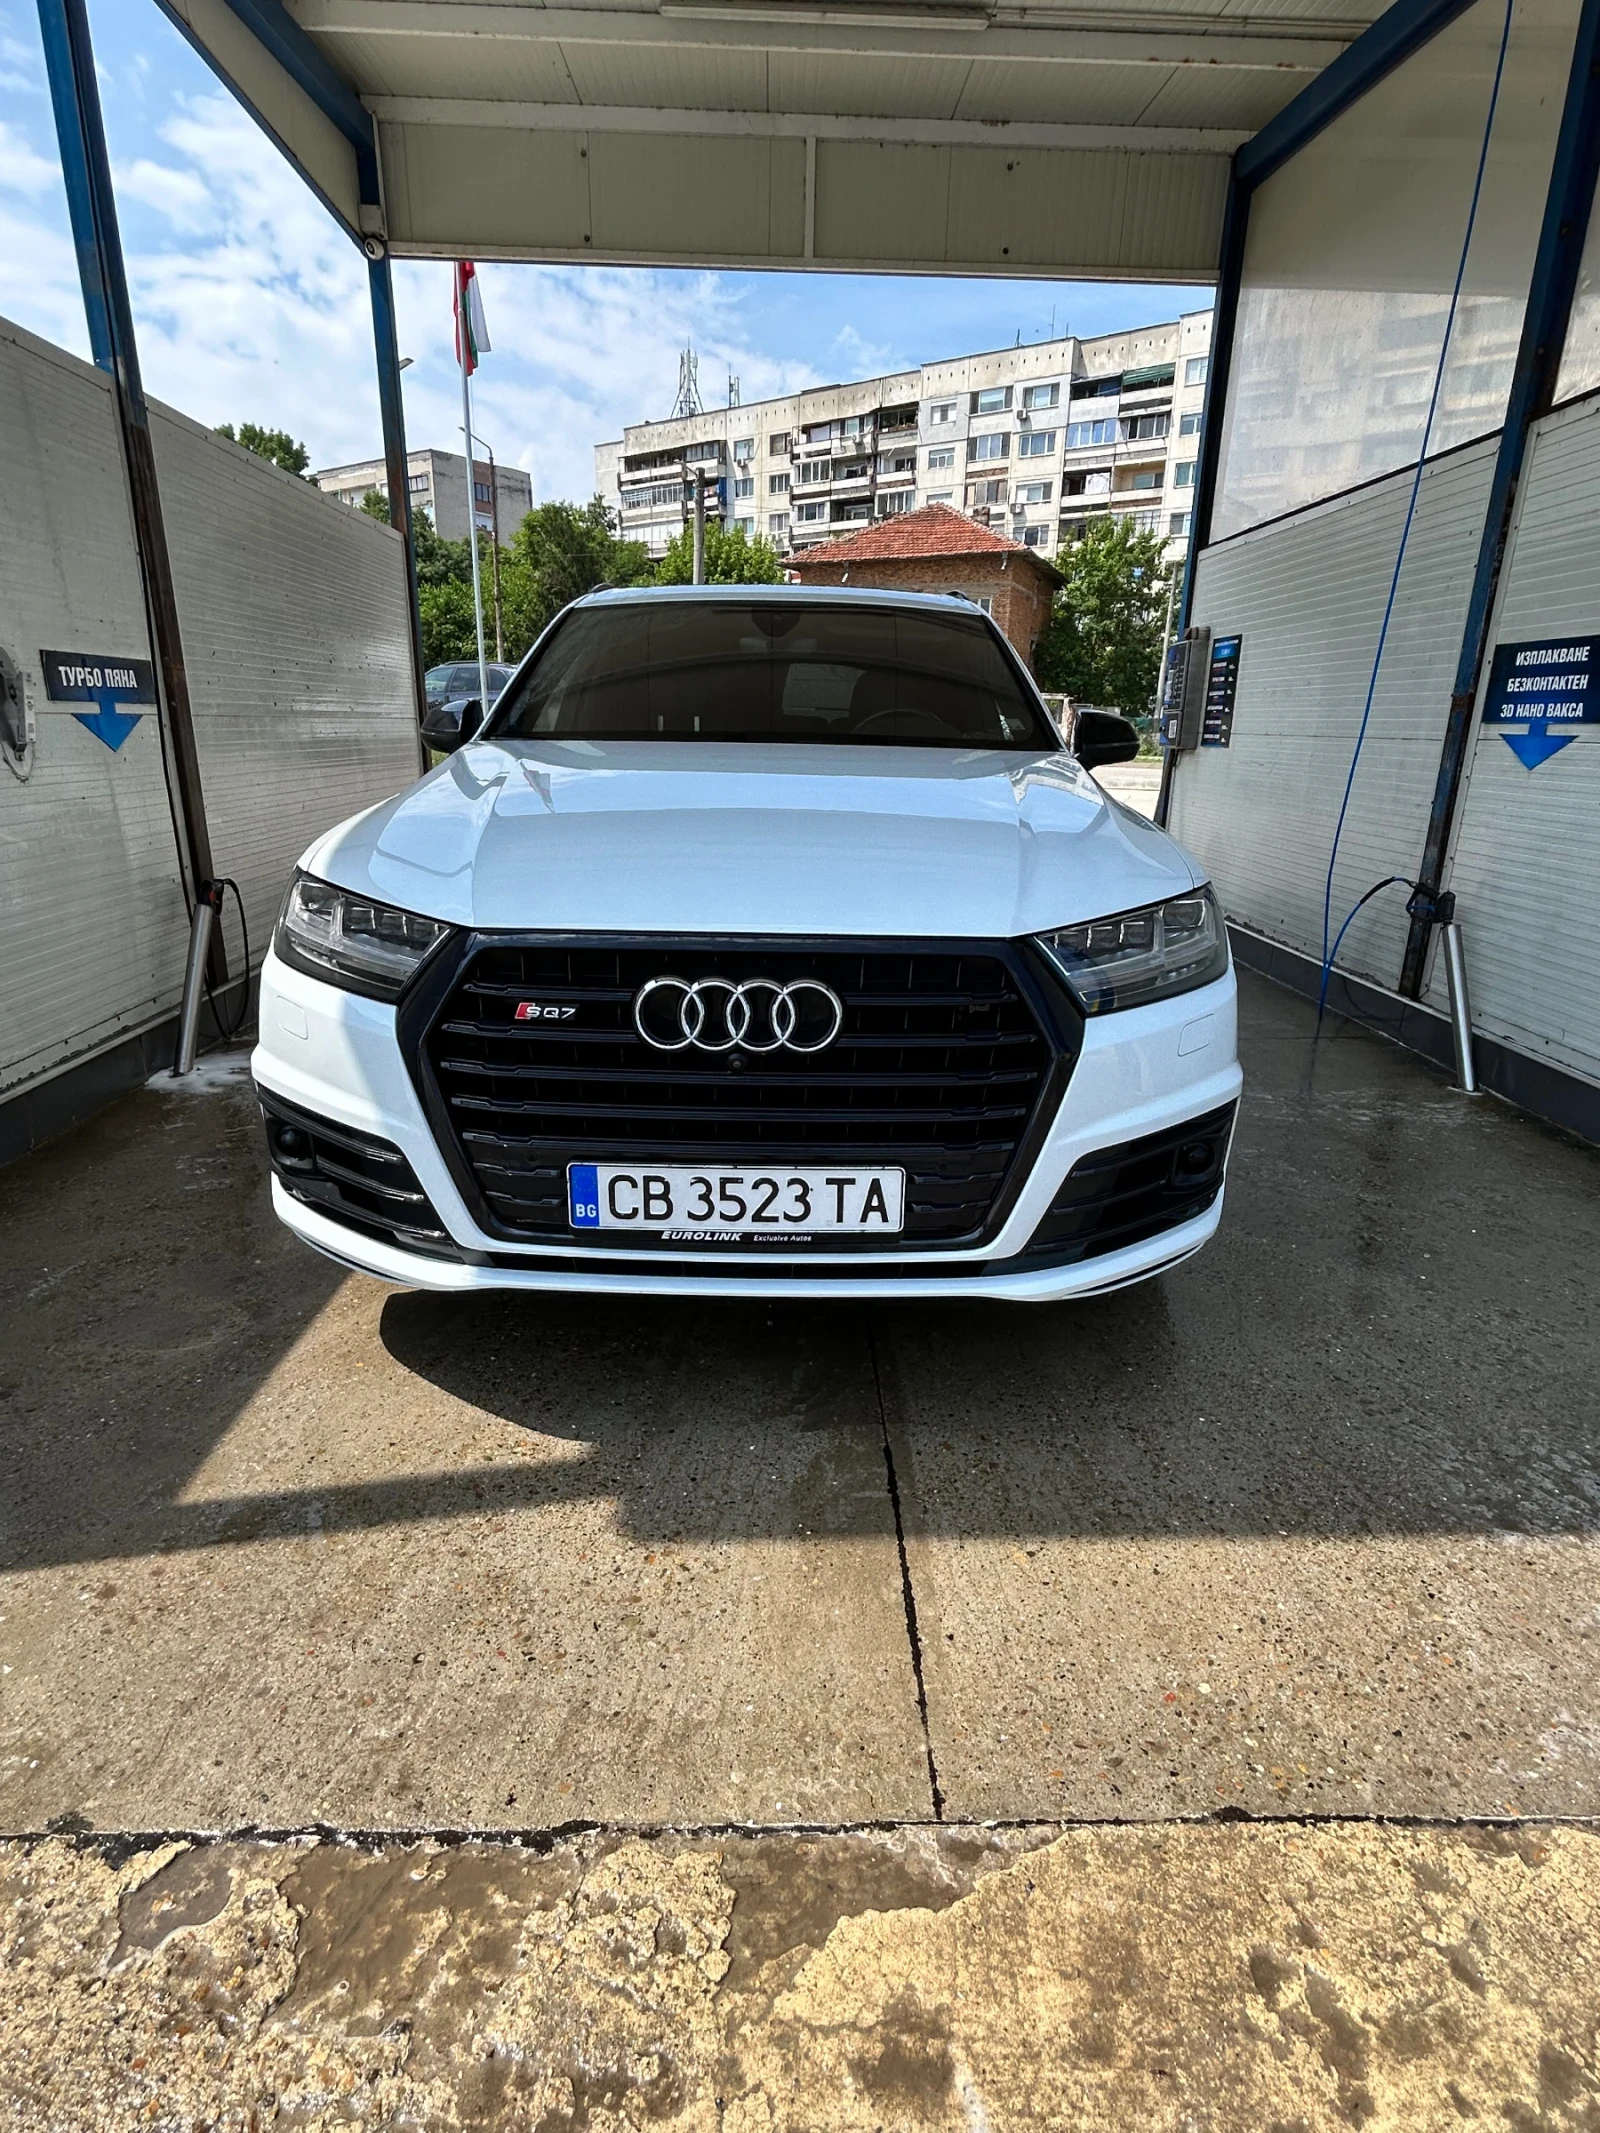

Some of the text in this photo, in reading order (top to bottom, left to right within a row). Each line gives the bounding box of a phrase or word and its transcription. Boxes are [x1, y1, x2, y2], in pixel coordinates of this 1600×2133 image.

[1515, 646, 1591, 666] ИЗПЛАКВАНЕ
[58, 665, 138, 688] ТУРБО ПЯНА
[1506, 674, 1589, 692] БЕЗКОНТАКТЕН
[1500, 702, 1584, 718] 3D НАНО ВАКСА
[523, 1005, 576, 1019] SQ7
[608, 1174, 889, 1223] CB 3523 TA
[575, 1203, 597, 1218] BG
[661, 1231, 743, 1241] EUROLINK
[753, 1234, 788, 1242] Exclusive
